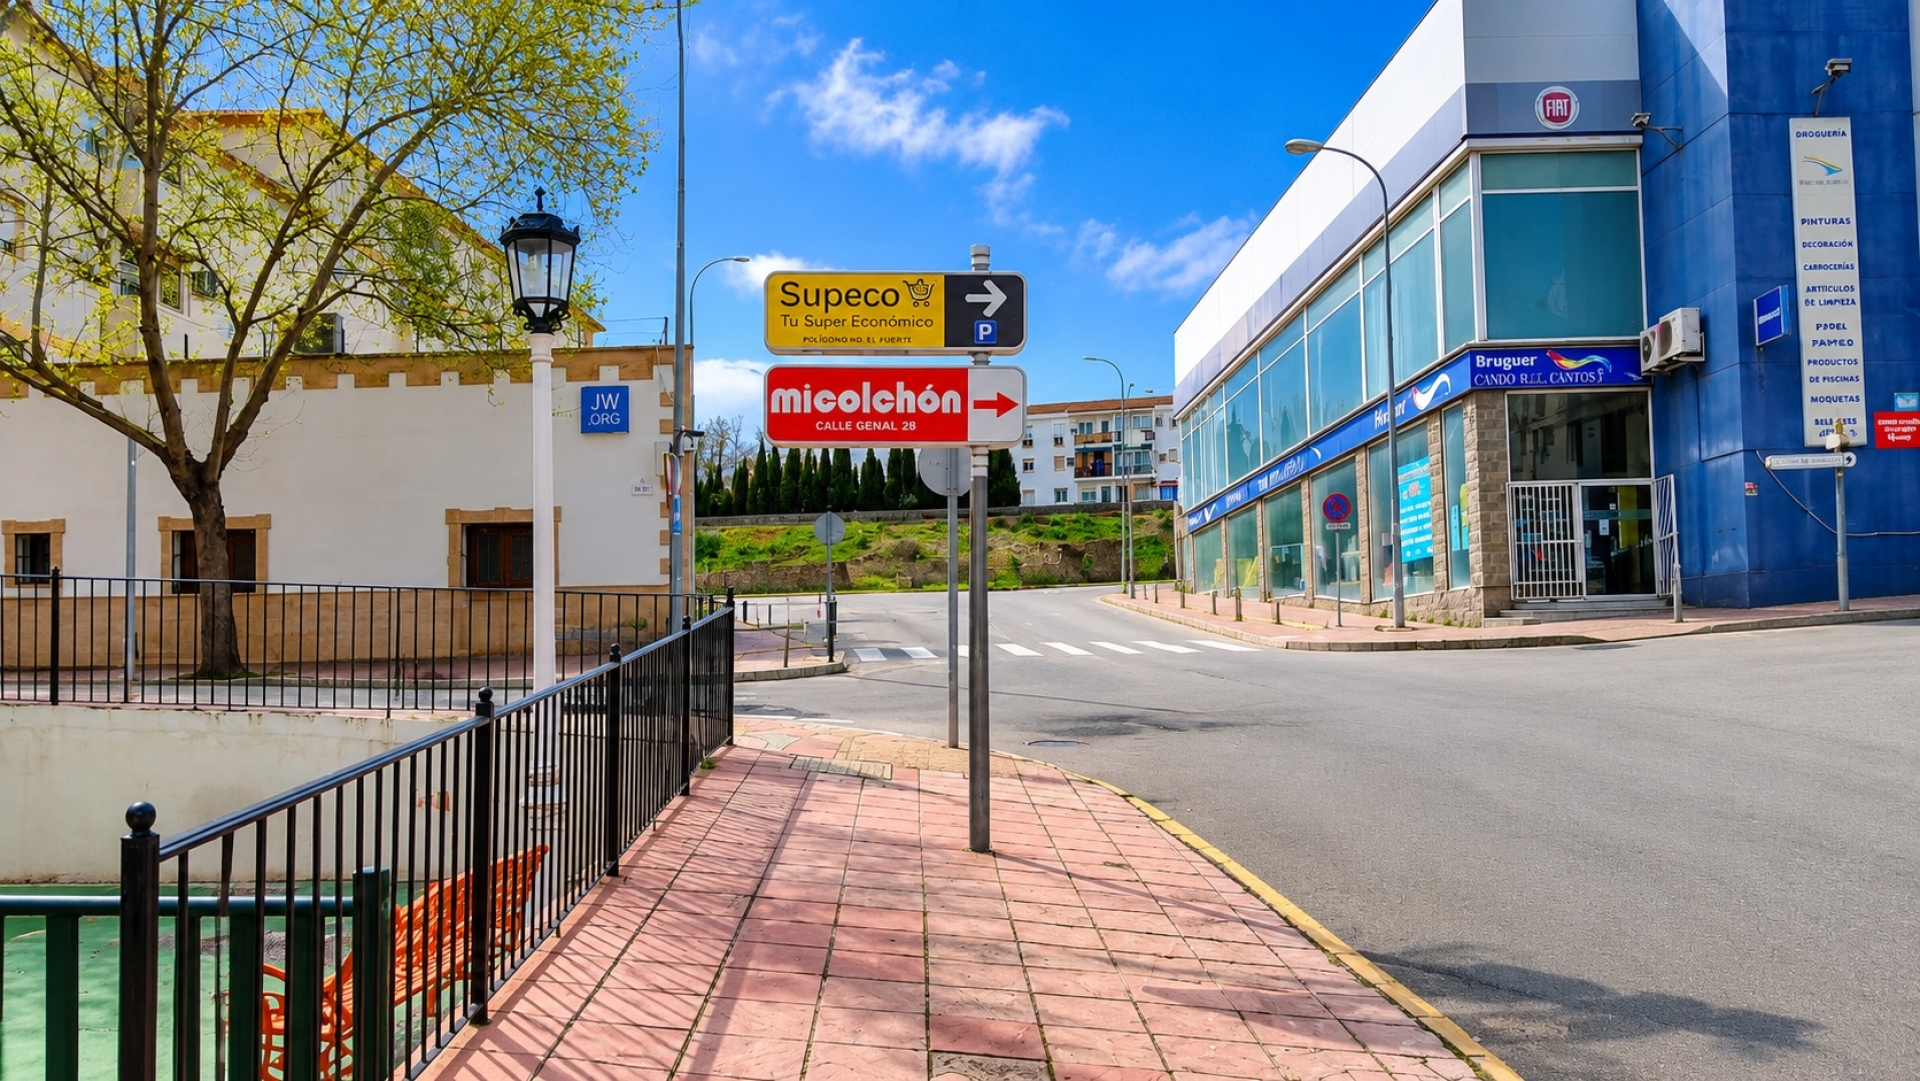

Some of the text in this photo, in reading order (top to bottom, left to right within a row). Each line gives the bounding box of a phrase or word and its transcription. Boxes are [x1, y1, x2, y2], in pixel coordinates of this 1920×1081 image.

[1545, 98, 1569, 117] FIAT
[1795, 128, 1847, 138] DROGUERÍA
[1801, 217, 1851, 226] PINTURAS
[1802, 239, 1853, 248] DECORACIÓN
[1803, 261, 1855, 271] CARROCERÍAS
[780, 281, 900, 313] Supeco
[780, 314, 934, 330] Tu Super Económico
[1475, 355, 1538, 370] Bruguer
[1807, 358, 1859, 366] PRODUCTOS
[590, 392, 620, 410] JW
[770, 381, 962, 414] micolchón
[1810, 395, 1860, 404] MOQUETAS
[587, 412, 621, 426] .ORG
[815, 420, 917, 431] CALLE GENAL 28
